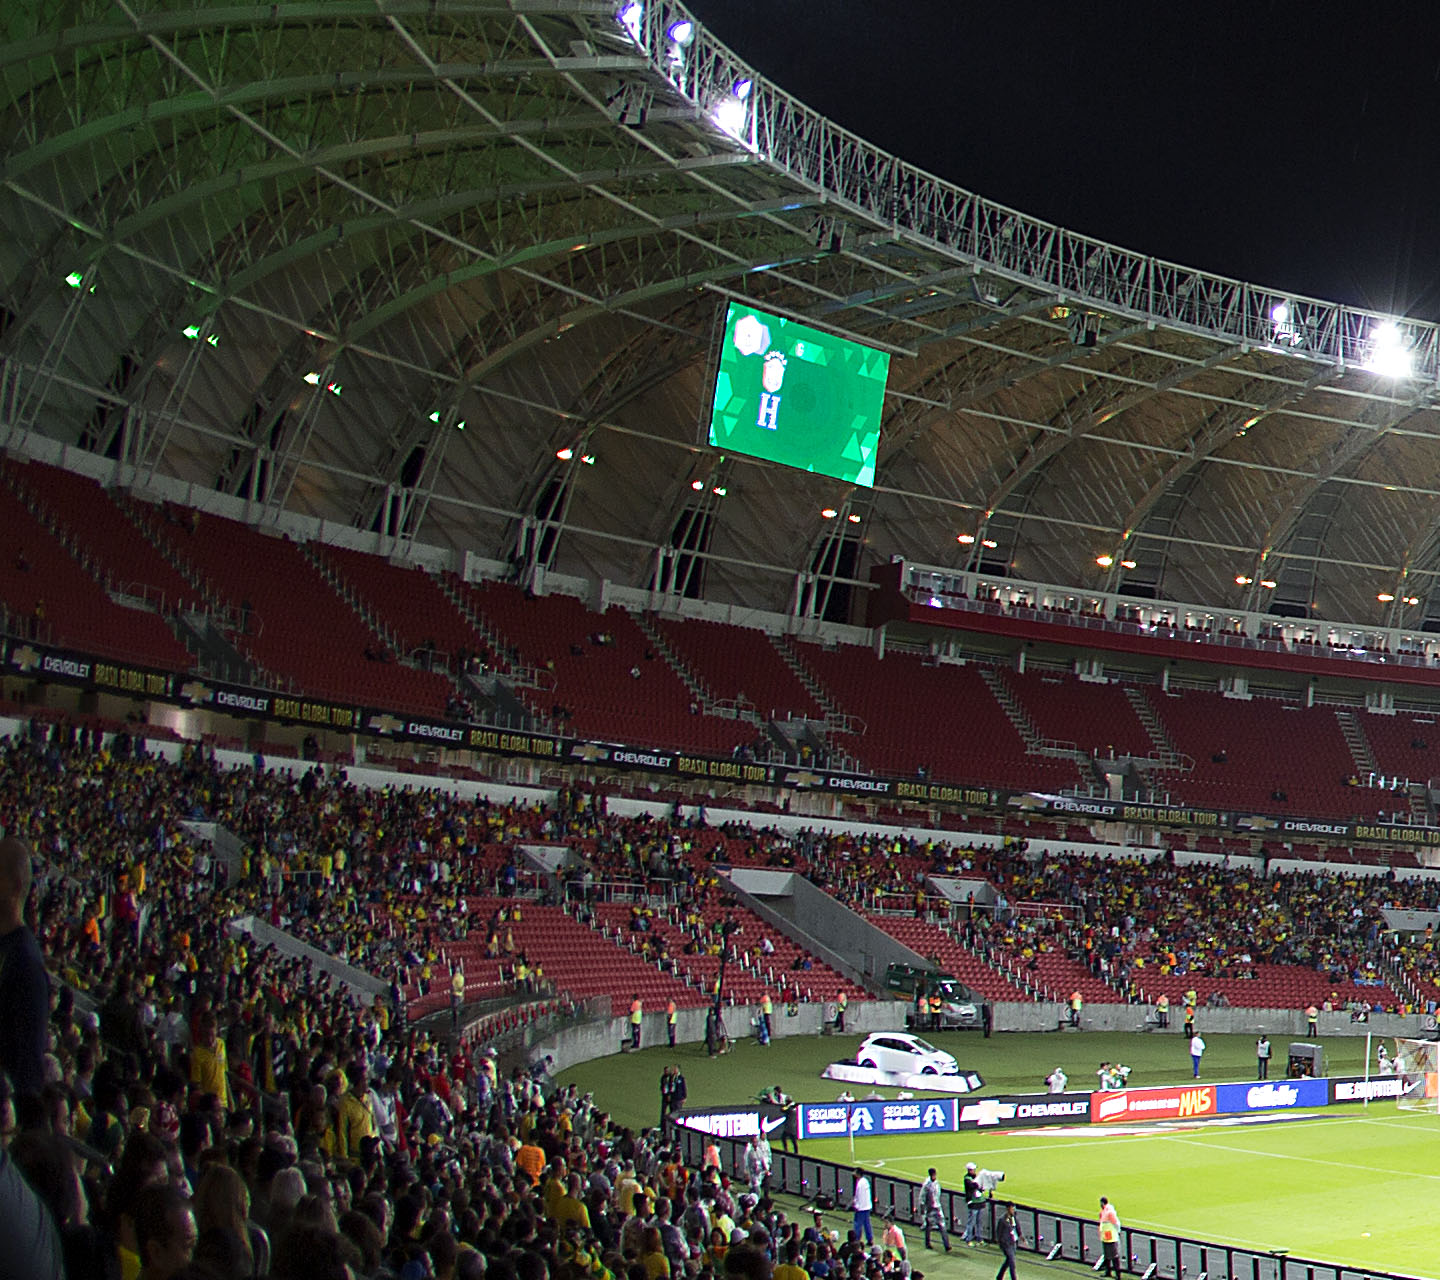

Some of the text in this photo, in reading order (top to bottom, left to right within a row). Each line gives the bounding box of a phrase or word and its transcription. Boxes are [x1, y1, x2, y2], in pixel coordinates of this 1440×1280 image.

[44, 656, 90, 678] CHEVROLET
[218, 691, 268, 712] CHEVROLET
[409, 723, 553, 755] CHEVROLET BRASIL GLOBAL TOUR
[614, 752, 766, 782] CHEVROLET BRASIL GLOBAL TOUR
[830, 778, 988, 804] CHEVROLET BRASIL GLOBAL TOUR
[1054, 802, 1218, 826] CHEVROLET BRASIL GLOBAL TOUR
[1285, 822, 1348, 834] CHEVROLET
[1356, 826, 1388, 838] BRASIL
[1390, 829, 1424, 842] GLOBAL
[1017, 1102, 1089, 1118] CHEVROLET
[1178, 1088, 1211, 1116] MAIS
